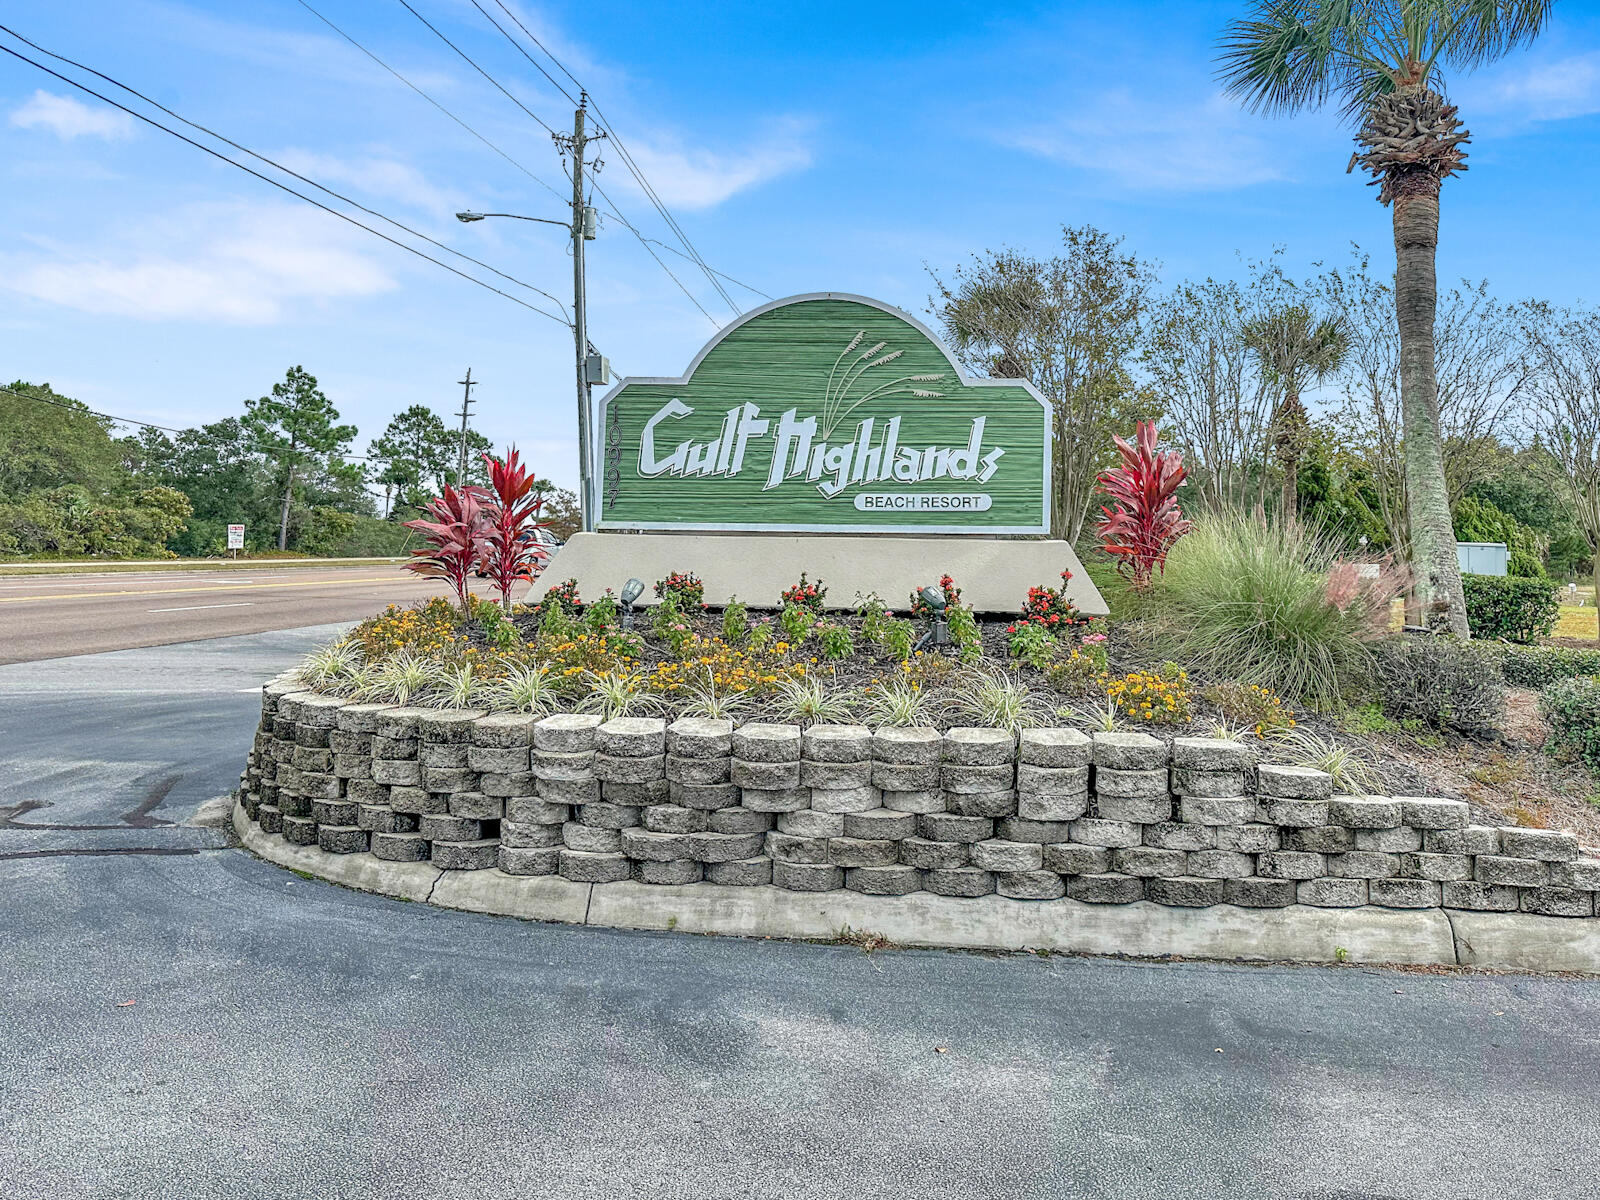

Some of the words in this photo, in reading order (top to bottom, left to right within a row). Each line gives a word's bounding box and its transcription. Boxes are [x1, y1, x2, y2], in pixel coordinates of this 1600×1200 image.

[607, 404, 622, 509] 10997
[636, 397, 770, 478] Gulf
[761, 406, 1006, 499] Highlands
[864, 496, 914, 509] BEACH
[920, 496, 981, 509] RESORT
